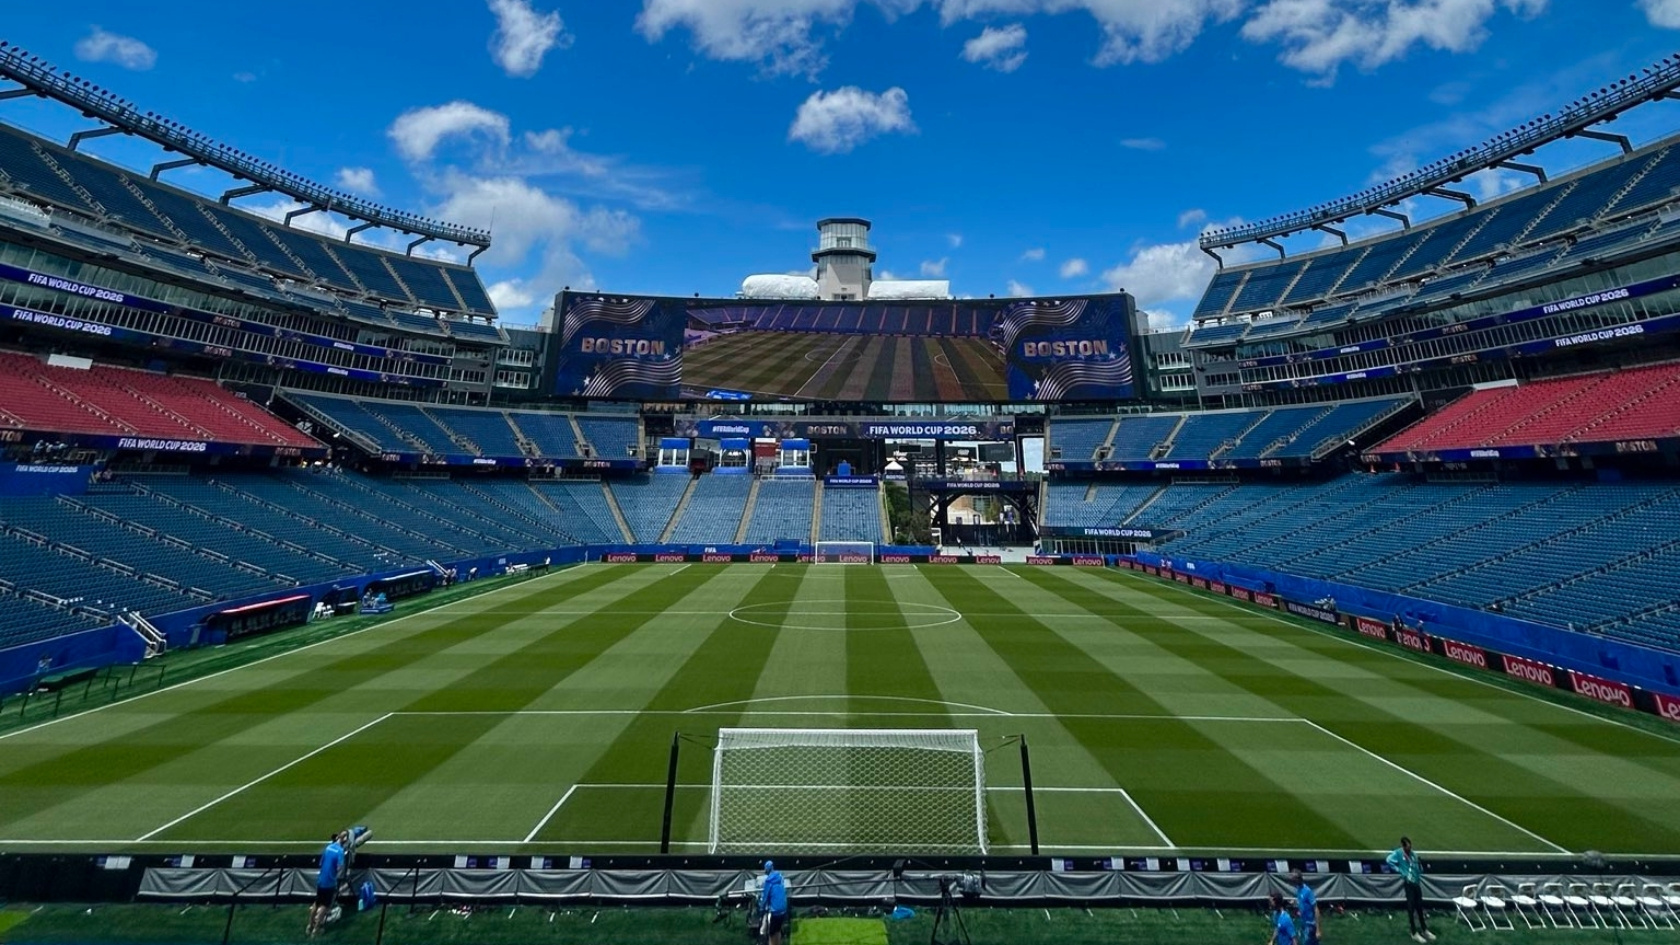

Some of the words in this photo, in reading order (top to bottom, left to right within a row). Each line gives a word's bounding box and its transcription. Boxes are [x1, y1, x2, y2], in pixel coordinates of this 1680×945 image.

[28, 273, 48, 285] FIFA
[48, 278, 78, 292] WORLD
[78, 286, 96, 296] CUP
[95, 289, 124, 302] 2026
[1543, 305, 1560, 314] FIFA
[1559, 298, 1586, 309] WORLD
[1585, 295, 1601, 305] CUP
[1600, 288, 1629, 301] 2026
[12, 309, 33, 321] FIFA
[33, 313, 65, 327] WORLD
[65, 320, 83, 330] CUP
[82, 323, 112, 335] 2026
[1554, 338, 1572, 347] FIFA
[1571, 333, 1598, 344] WORLD
[1598, 330, 1614, 340] CUP
[1614, 324, 1644, 337] 2026
[581, 337, 665, 355] BOSTON
[1023, 340, 1109, 357] BOSTON
[807, 425, 847, 434] BOSTON
[869, 425, 888, 435] FIFA
[890, 425, 923, 435] WORLD
[924, 425, 944, 435] CUP
[944, 425, 977, 435] 2026
[118, 438, 137, 448] FIFA
[137, 439, 165, 450] WORLD
[165, 441, 181, 450] CUP
[180, 442, 207, 451] 2026
[1615, 440, 1658, 452] BOSTON
[15, 464, 29, 472] FIFA
[1098, 528, 1121, 536] WORLD
[1120, 529, 1133, 537] CUP
[607, 554, 637, 562] Lenovo
[655, 554, 684, 562] Lenovo
[702, 554, 732, 562] Lenovo
[750, 554, 779, 562] Lenovo
[839, 555, 868, 563] Lenovo
[881, 555, 910, 563] Lenovo
[928, 555, 958, 563] Lenovo
[1073, 557, 1101, 566] Lenovo
[1356, 617, 1386, 638] Lenovo
[1443, 641, 1485, 667] Lenovo
[1502, 655, 1552, 684] Lenovo
